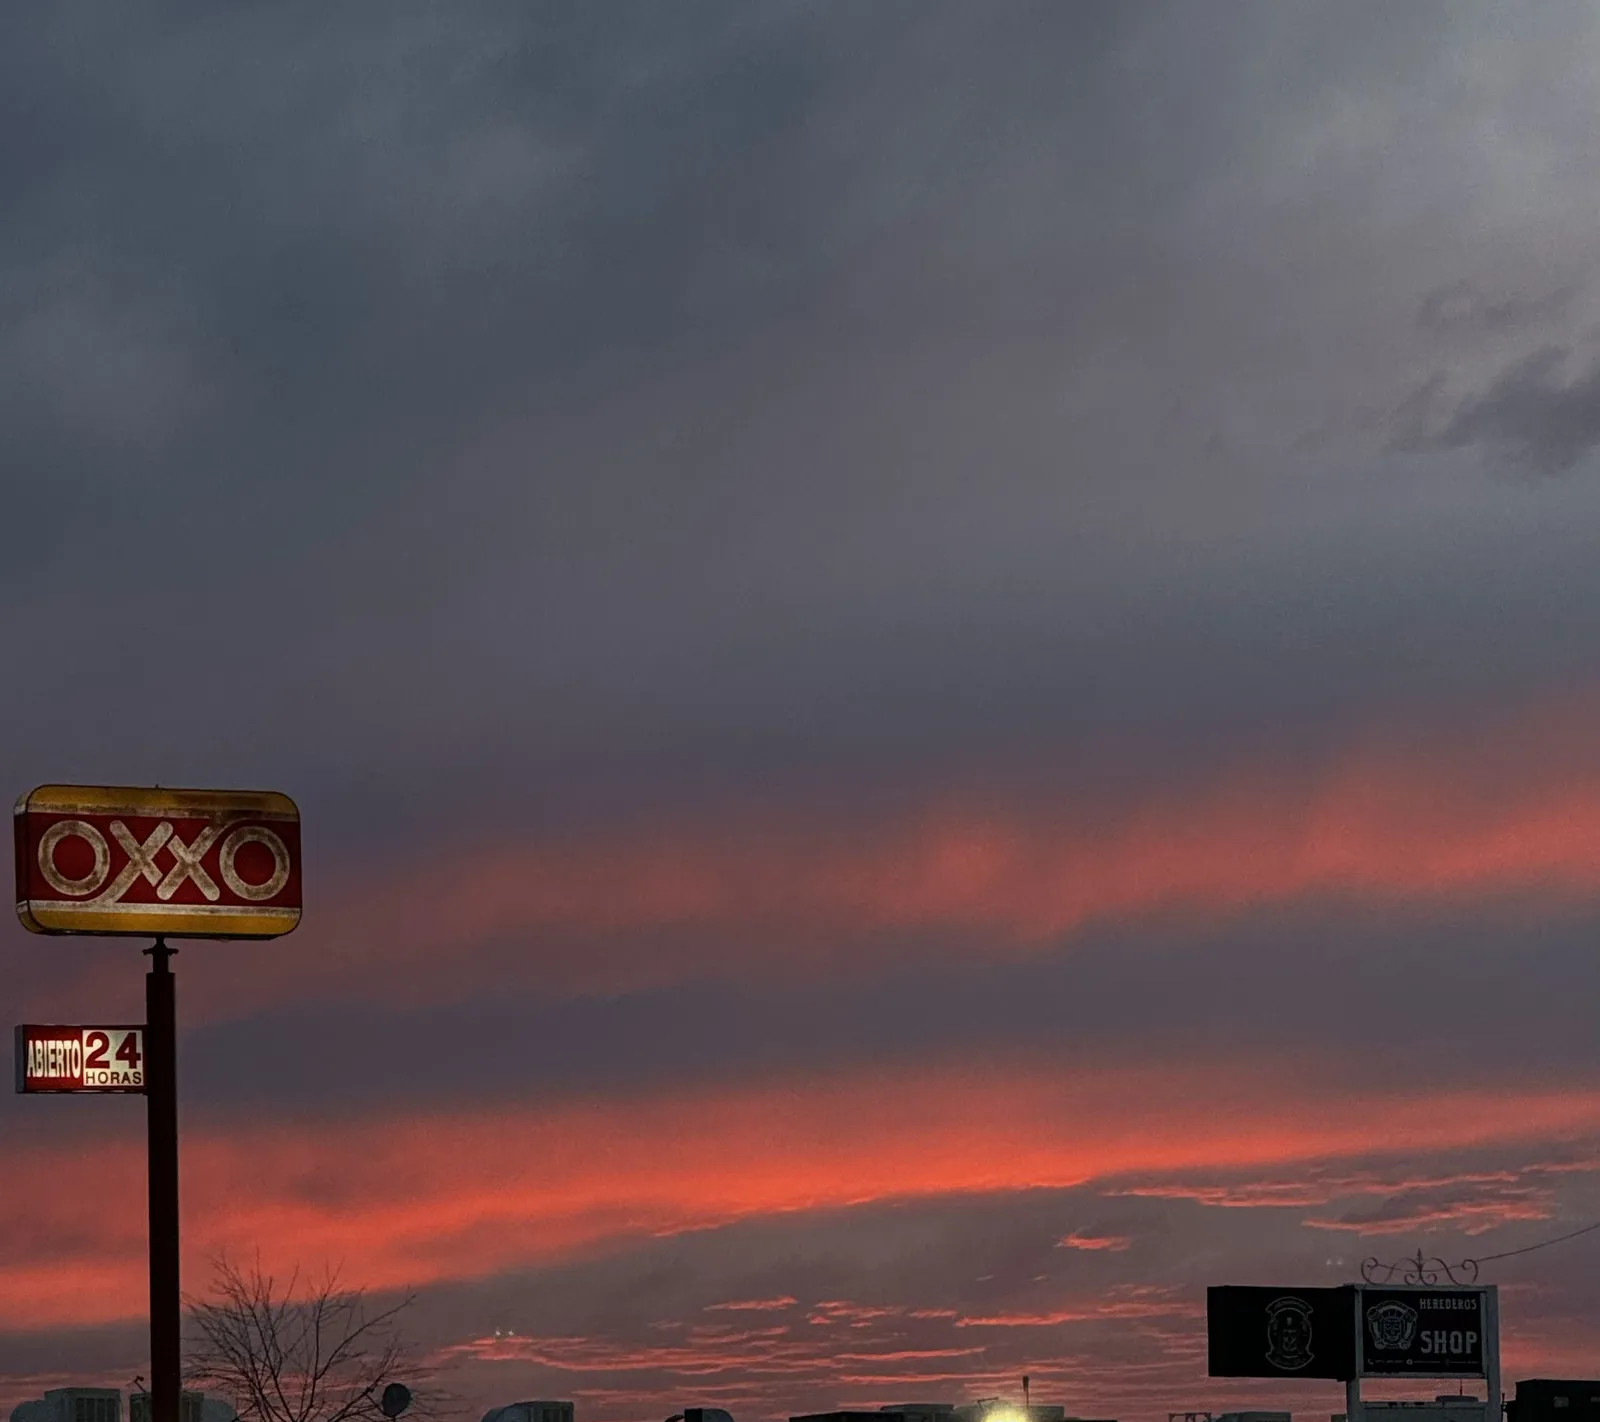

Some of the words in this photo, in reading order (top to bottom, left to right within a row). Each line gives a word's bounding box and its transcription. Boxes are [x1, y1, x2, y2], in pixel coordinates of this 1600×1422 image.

[38, 819, 290, 901] OXXO
[27, 1039, 81, 1079] ABIERTO
[85, 1031, 141, 1069] 24
[85, 1071, 142, 1085] HORAS
[1419, 1298, 1477, 1310] HEREDEROS
[1420, 1330, 1478, 1354] SHOP
